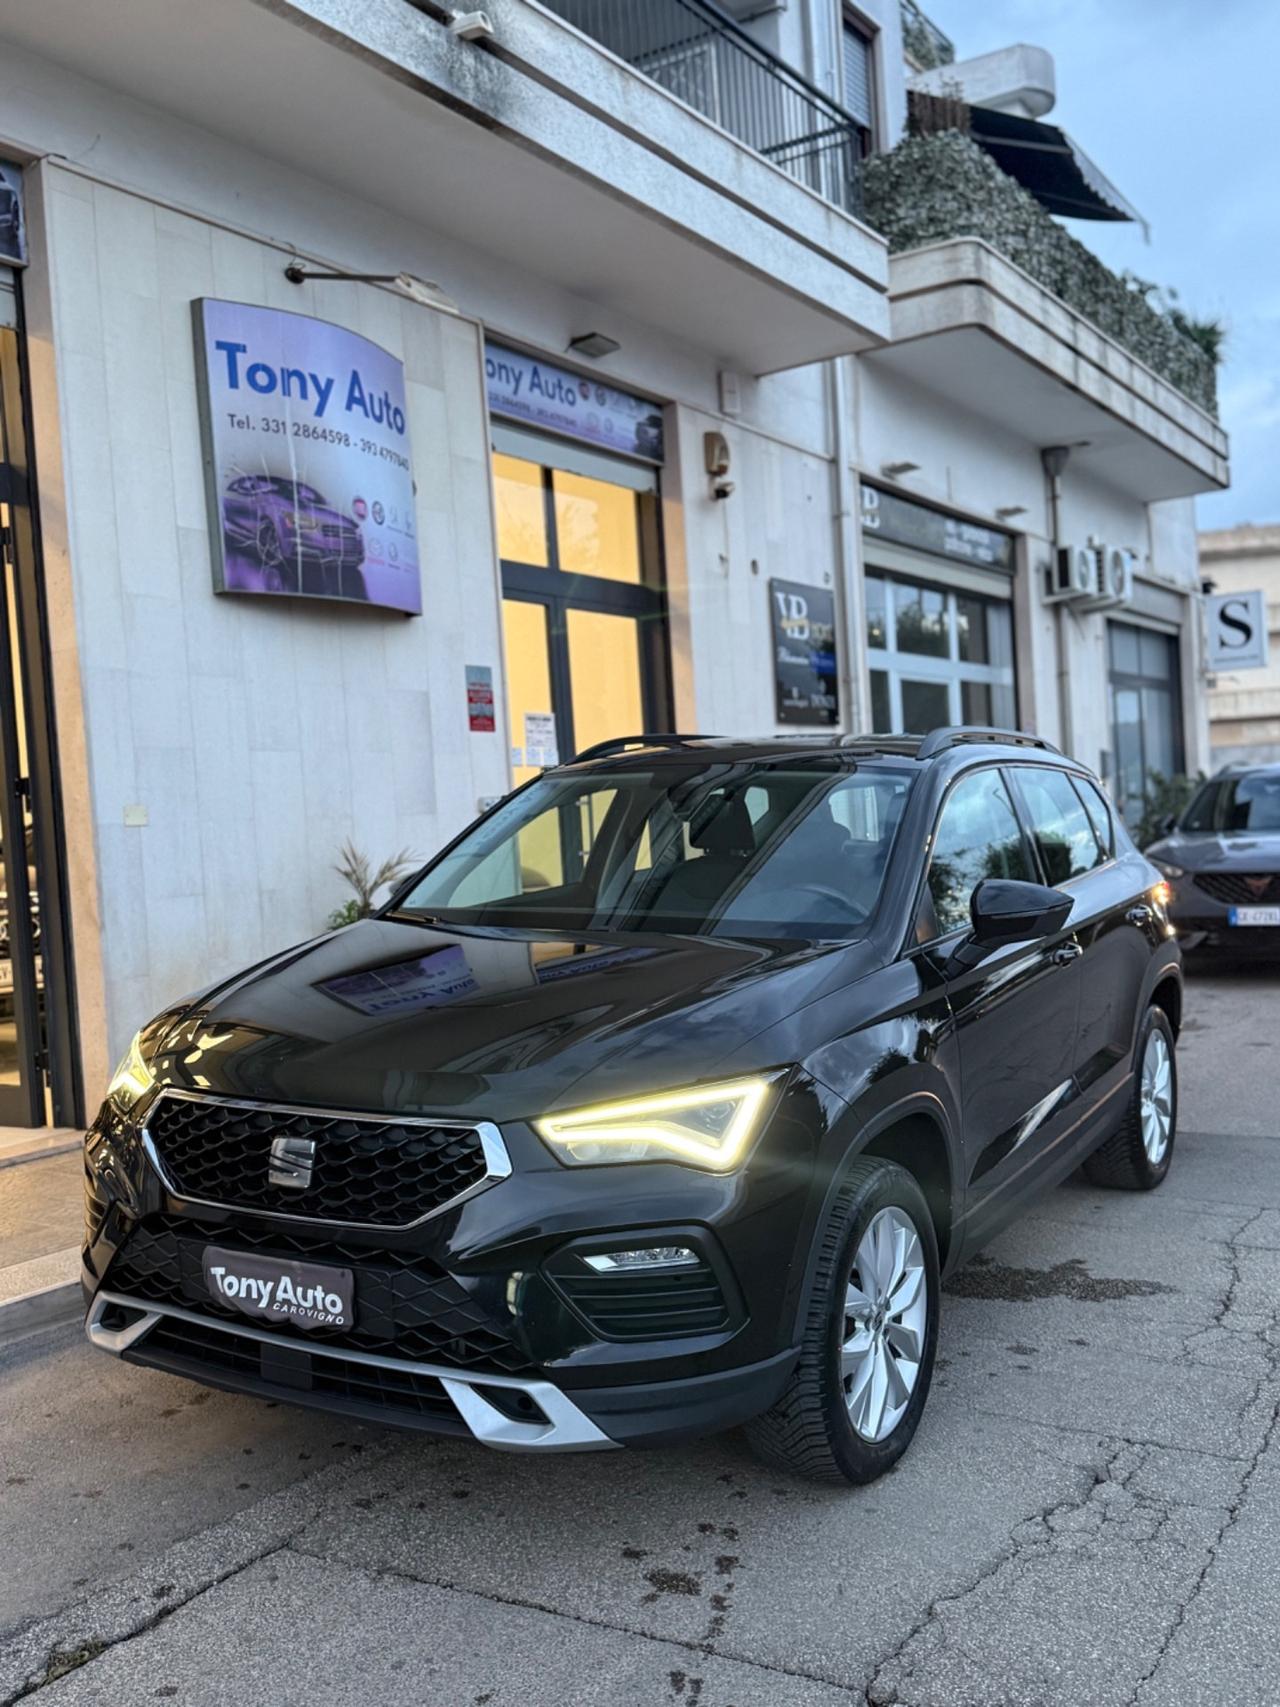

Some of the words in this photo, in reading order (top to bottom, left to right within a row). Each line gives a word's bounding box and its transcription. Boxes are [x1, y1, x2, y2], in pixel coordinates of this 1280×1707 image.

[215, 341, 334, 417] Tony
[345, 368, 406, 436] Auto
[485, 359, 522, 395] ony
[529, 366, 576, 406] Auto
[228, 413, 256, 431] Tel.
[261, 417, 287, 435] 331
[292, 422, 351, 448] 2864598
[360, 437, 378, 457] 393
[1218, 599, 1253, 650] S
[210, 1266, 275, 1308] Tony
[275, 1275, 344, 1315] Auto
[272, 1302, 345, 1325] CAROVIGNO
